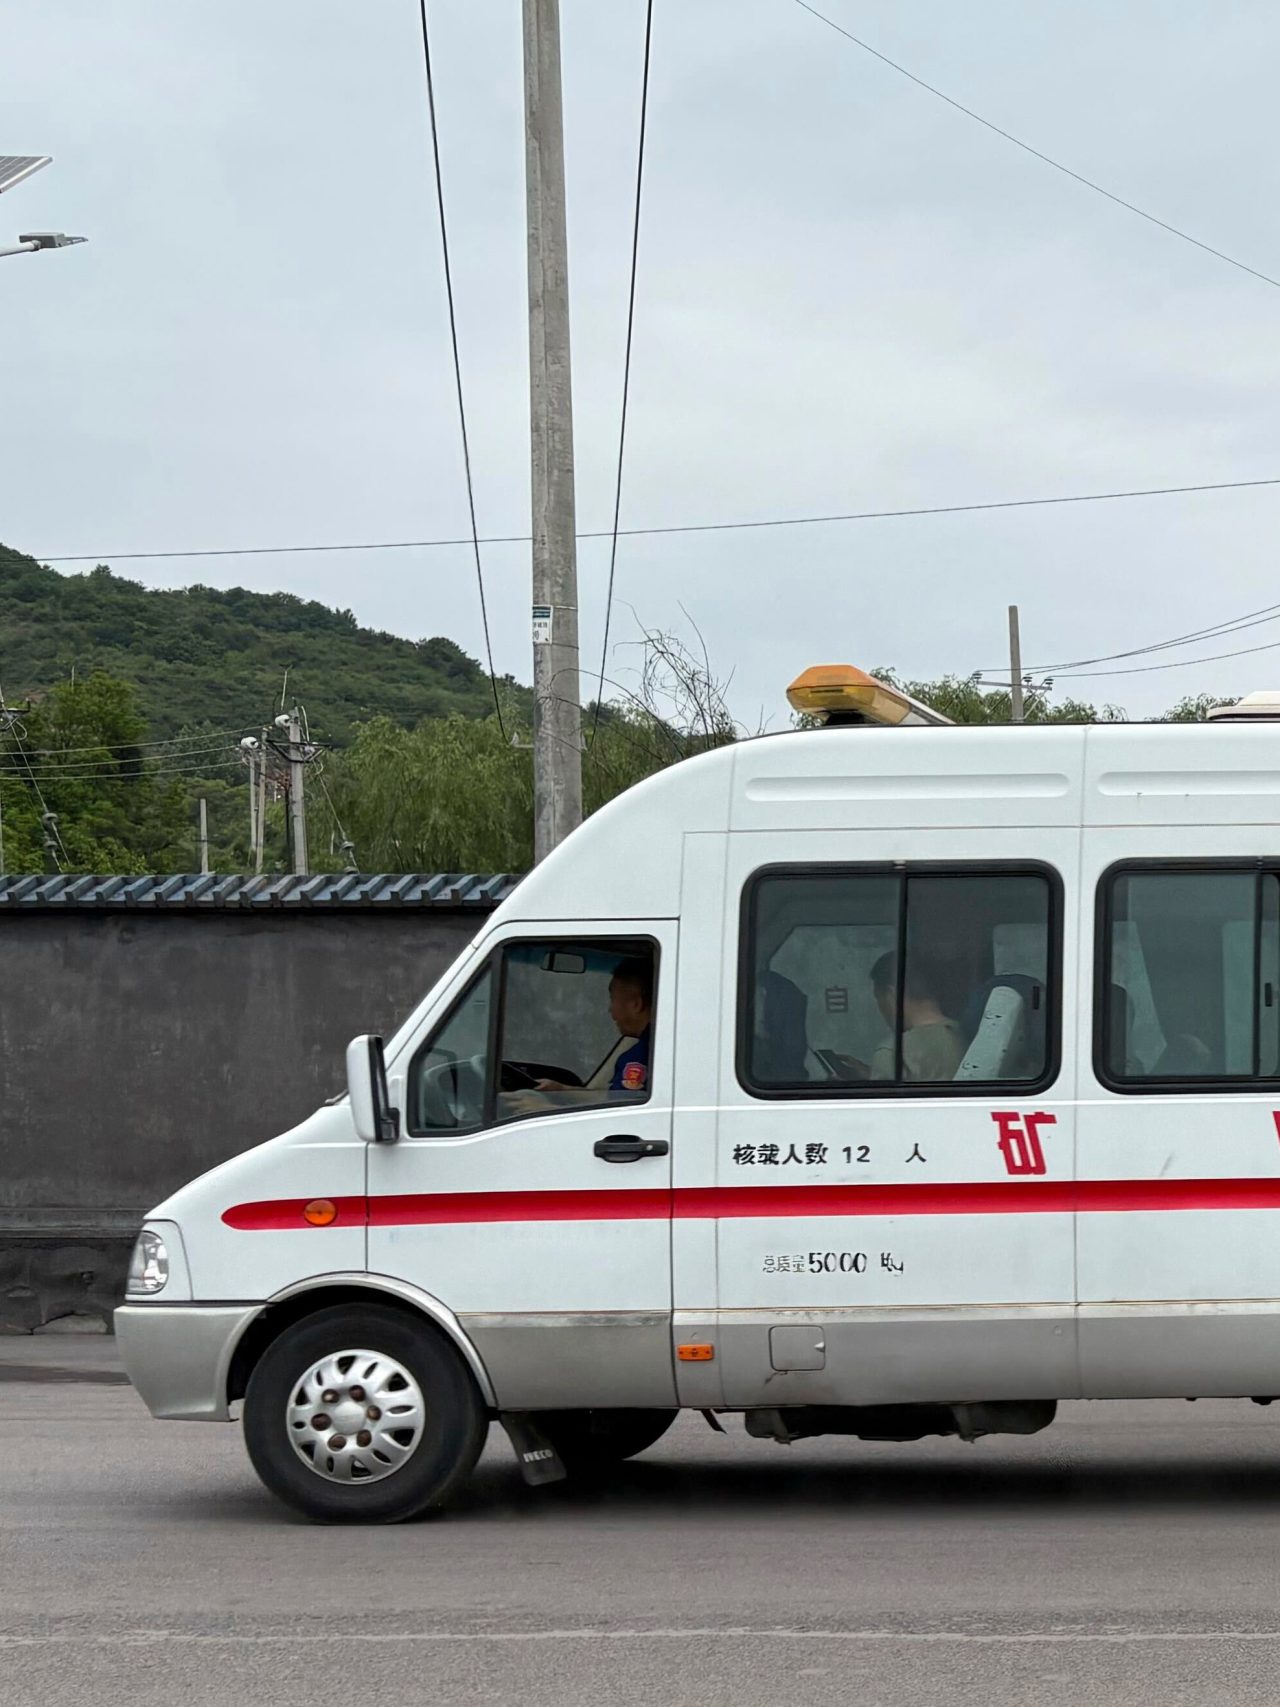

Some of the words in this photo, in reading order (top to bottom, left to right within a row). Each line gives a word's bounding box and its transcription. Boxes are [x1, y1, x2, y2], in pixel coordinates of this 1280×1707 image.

[732, 1142, 829, 1166] 核载人数
[842, 1145, 871, 1164] 12
[904, 1142, 927, 1164] 人
[990, 1111, 1058, 1175] 矿
